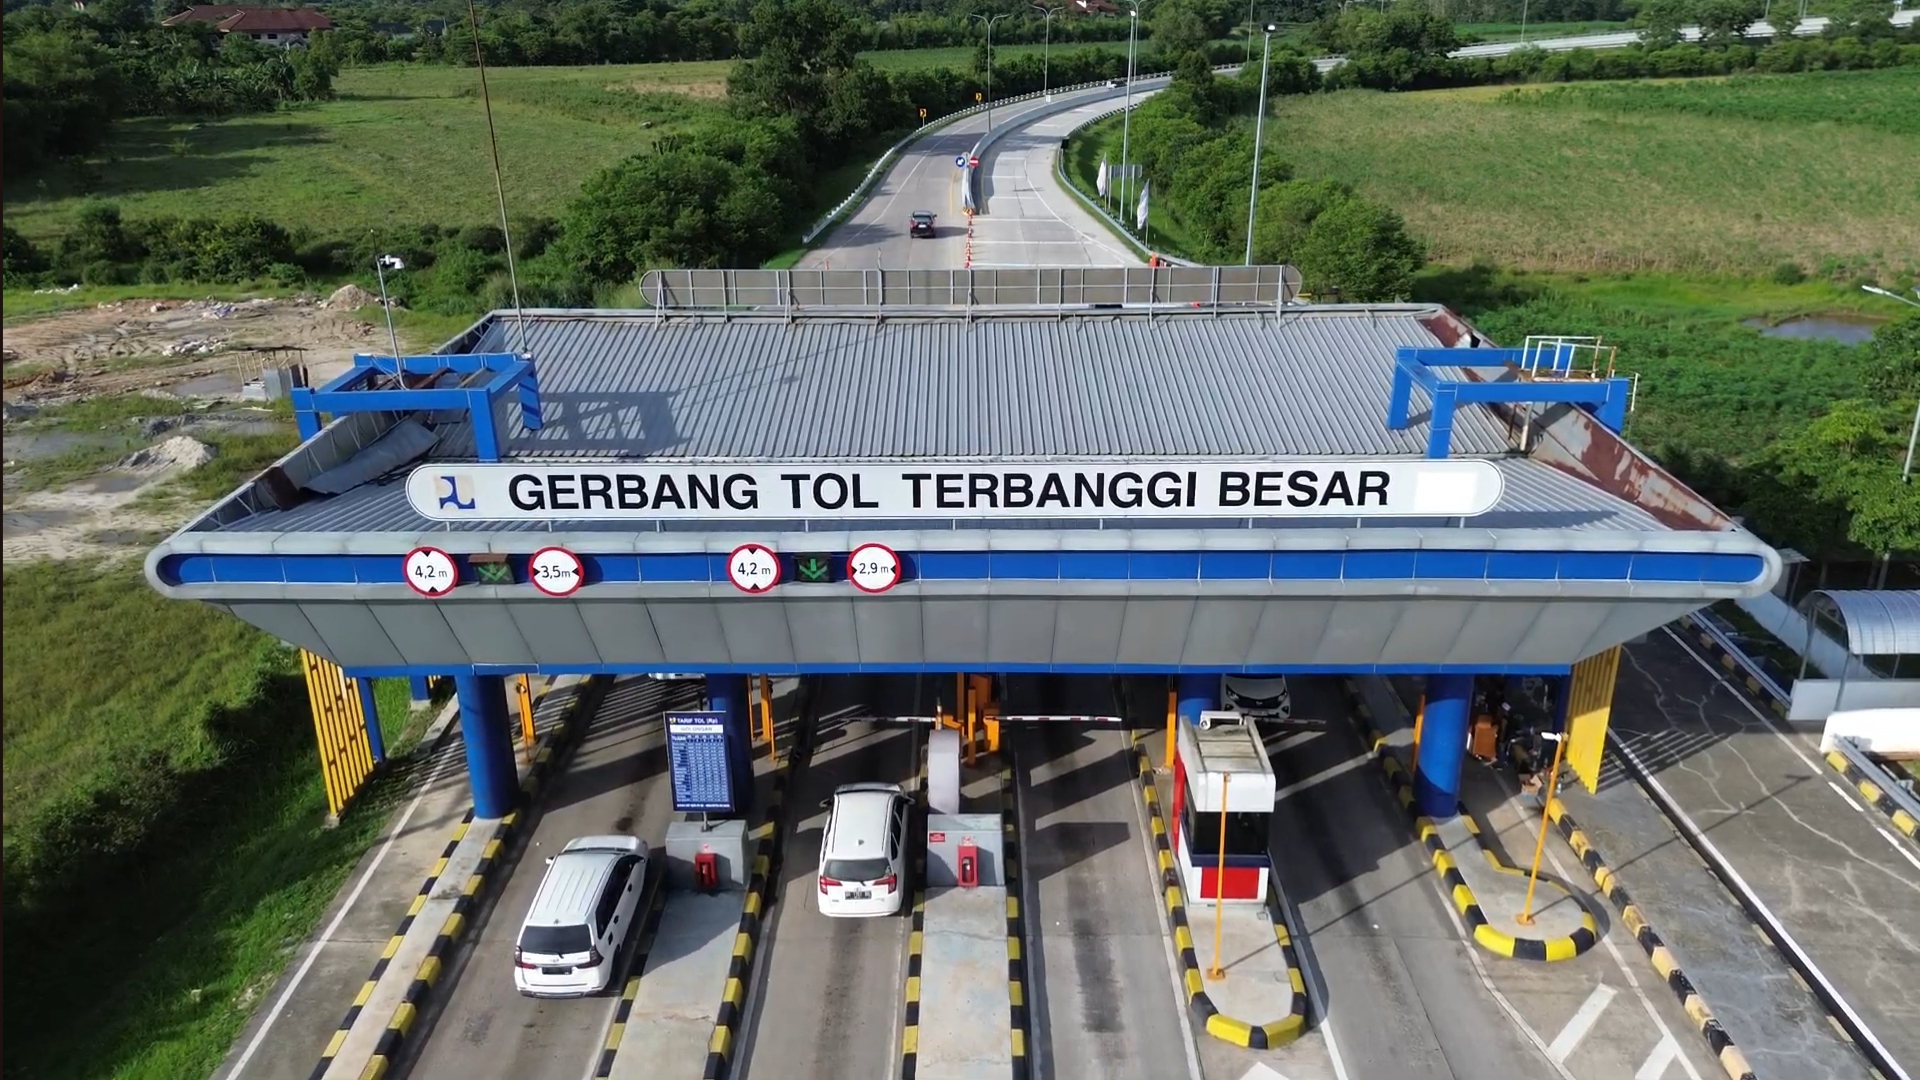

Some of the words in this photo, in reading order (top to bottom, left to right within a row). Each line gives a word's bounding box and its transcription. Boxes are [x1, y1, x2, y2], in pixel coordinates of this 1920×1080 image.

[508, 473, 759, 511] GERBANG
[780, 472, 879, 510] TOL
[901, 471, 1197, 509] TERBANGGI
[1218, 470, 1390, 508] BESAR
[414, 564, 436, 580] 4,2
[737, 562, 758, 578] 4,2
[859, 562, 878, 576] 2,9
